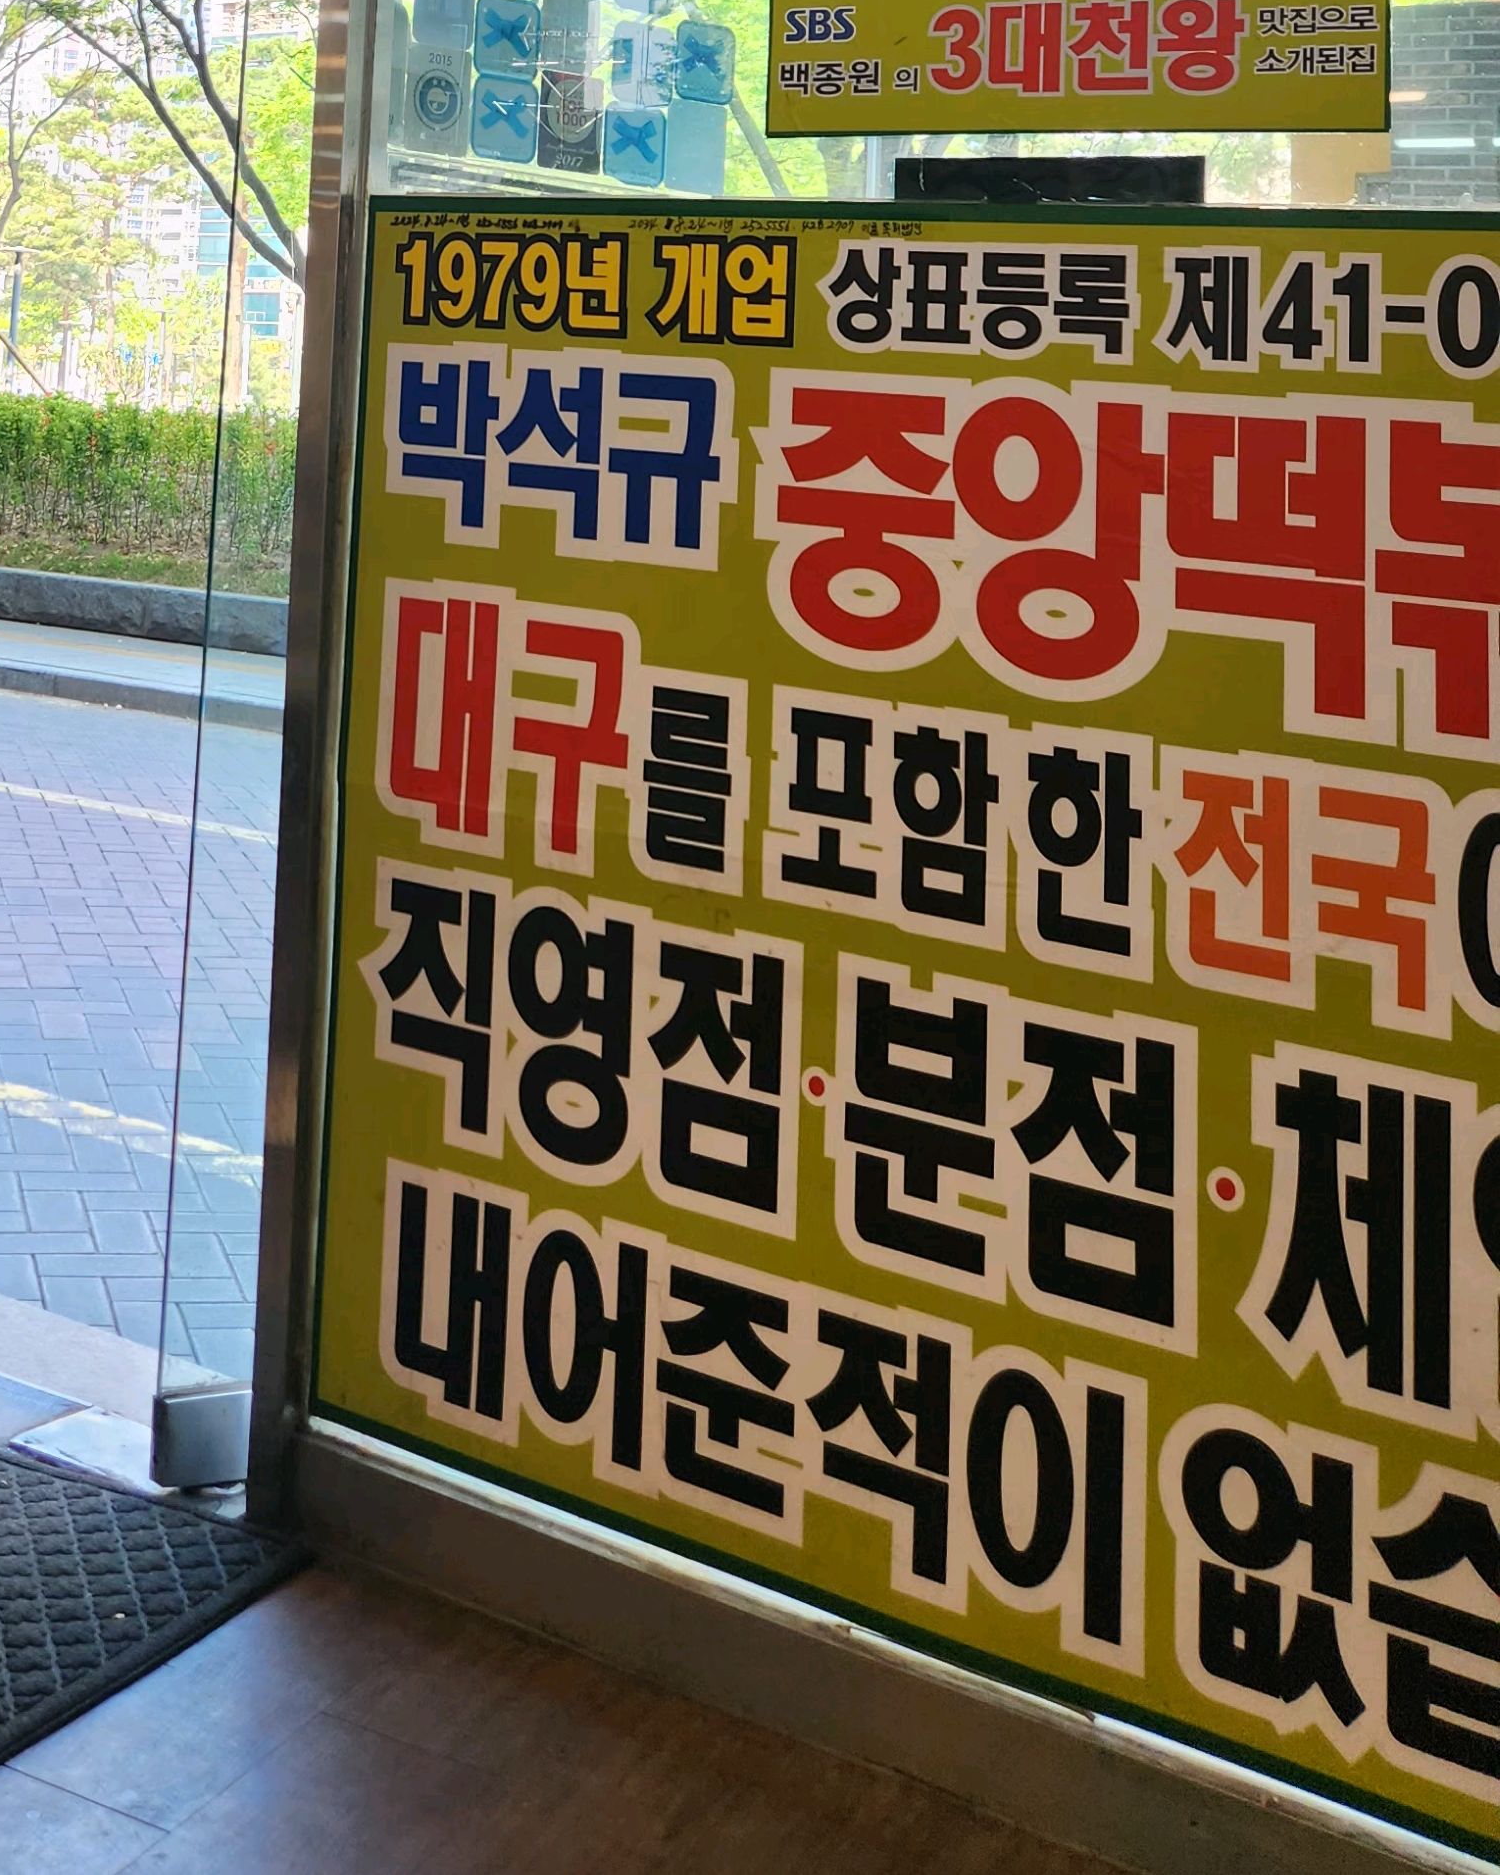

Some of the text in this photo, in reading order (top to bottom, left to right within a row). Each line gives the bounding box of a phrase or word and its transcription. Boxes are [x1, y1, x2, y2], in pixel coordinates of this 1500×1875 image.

[785, 9, 854, 40] SBS
[1259, 6, 1378, 34] 맛집으로
[429, 52, 453, 65] 2015
[1255, 46, 1375, 74] 소개된집
[779, 61, 919, 93] 백종원 의
[400, 239, 625, 327] 1979년
[655, 241, 794, 339] 개업
[830, 249, 1129, 355] 상표등록
[395, 360, 720, 552] 박석규
[389, 595, 730, 871] 대구를
[783, 707, 1142, 965] 포함한
[398, 1181, 1125, 1645] 내어준적이
